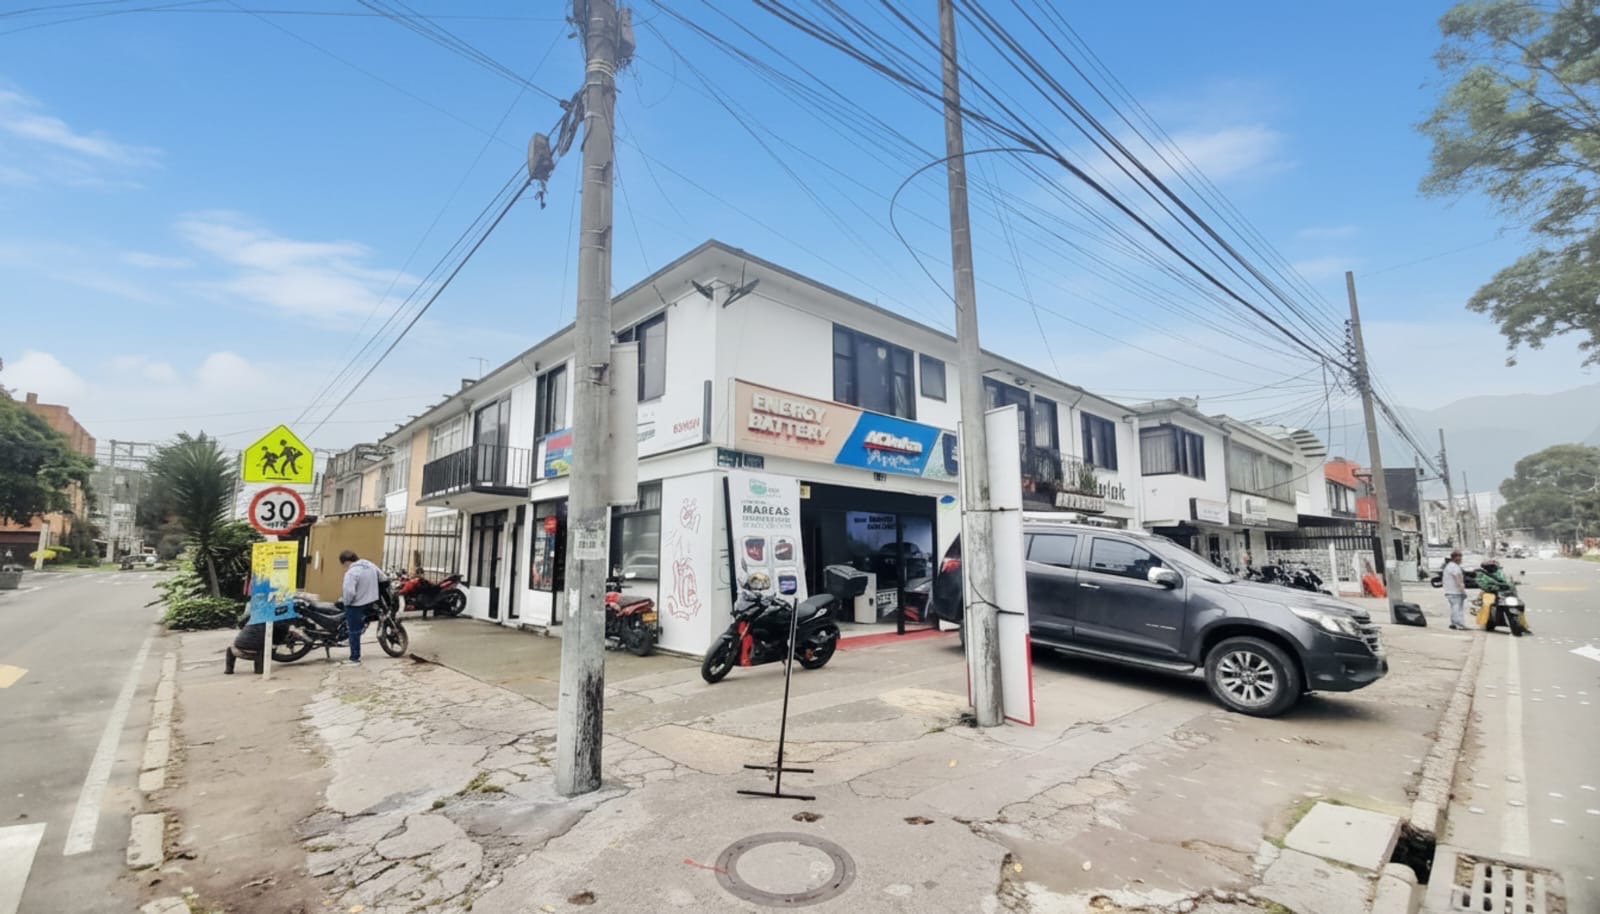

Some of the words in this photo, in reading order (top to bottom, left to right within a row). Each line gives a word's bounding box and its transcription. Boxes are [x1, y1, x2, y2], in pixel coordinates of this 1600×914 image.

[752, 391, 826, 425] ENERGY
[748, 413, 831, 444] BATTERY
[260, 501, 295, 521] 30
